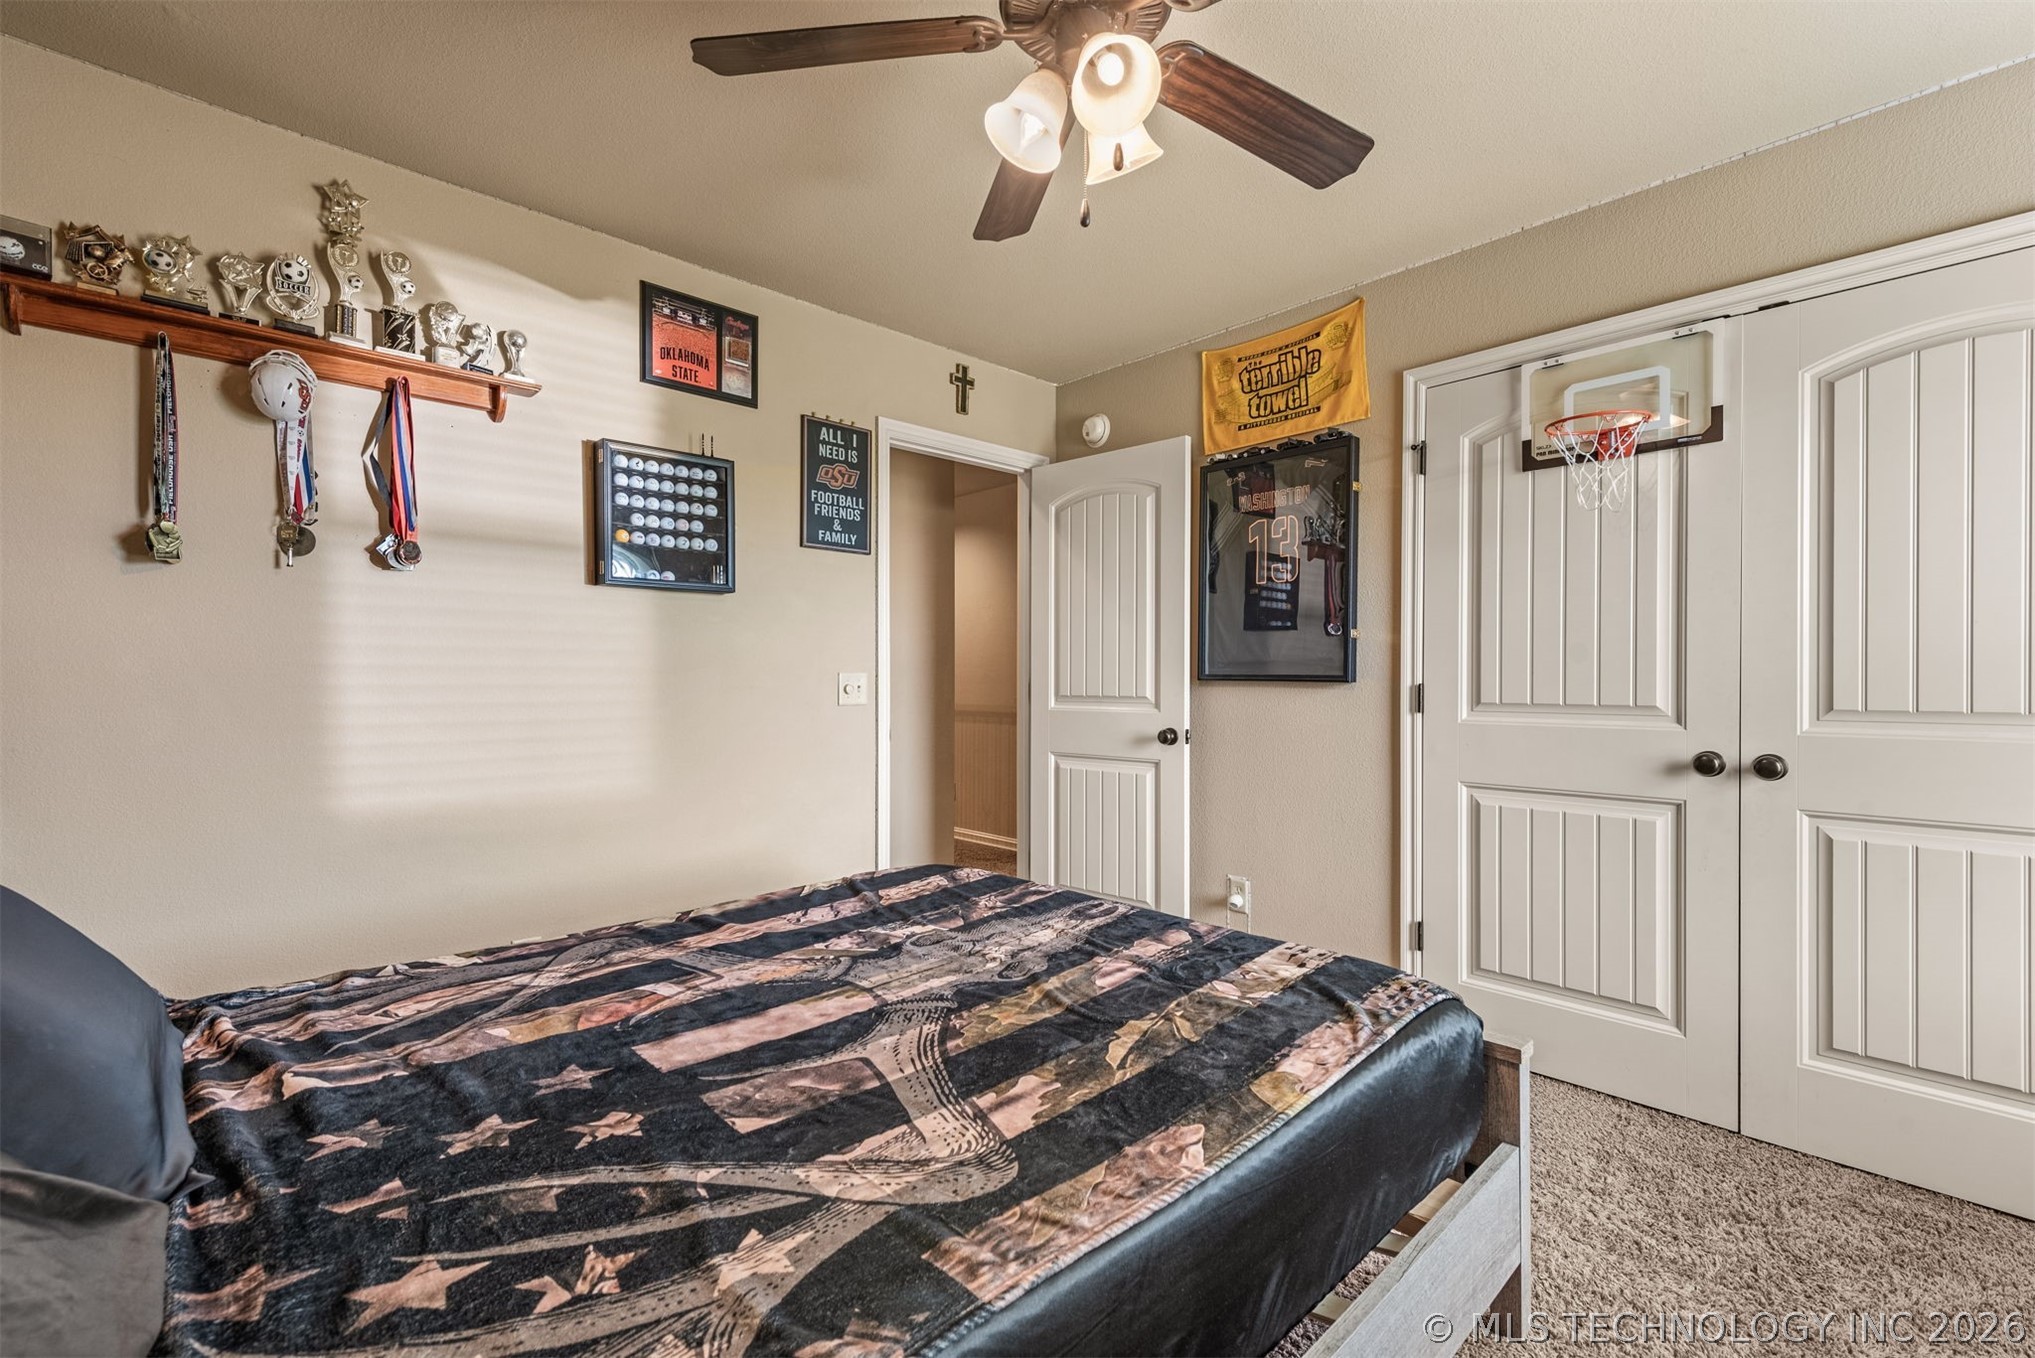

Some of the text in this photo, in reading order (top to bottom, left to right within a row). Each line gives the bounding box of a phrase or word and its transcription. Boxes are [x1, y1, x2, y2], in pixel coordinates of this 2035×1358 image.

[277, 279, 311, 295] SOCCER
[659, 346, 710, 372] OKLAHOMA
[1239, 345, 1322, 395] terrible
[1248, 360, 1262, 369] The
[1248, 375, 1309, 419] towel
[819, 426, 857, 448] ALL I
[818, 443, 858, 464] NEED IS
[816, 463, 860, 490] OSU
[810, 489, 865, 511] FOOTBALL
[1238, 484, 1311, 514] WASHINGTON
[814, 503, 861, 522] FRIENDS
[832, 518, 843, 532] &
[818, 529, 857, 546] FAMILY
[1248, 515, 1300, 585] 13
